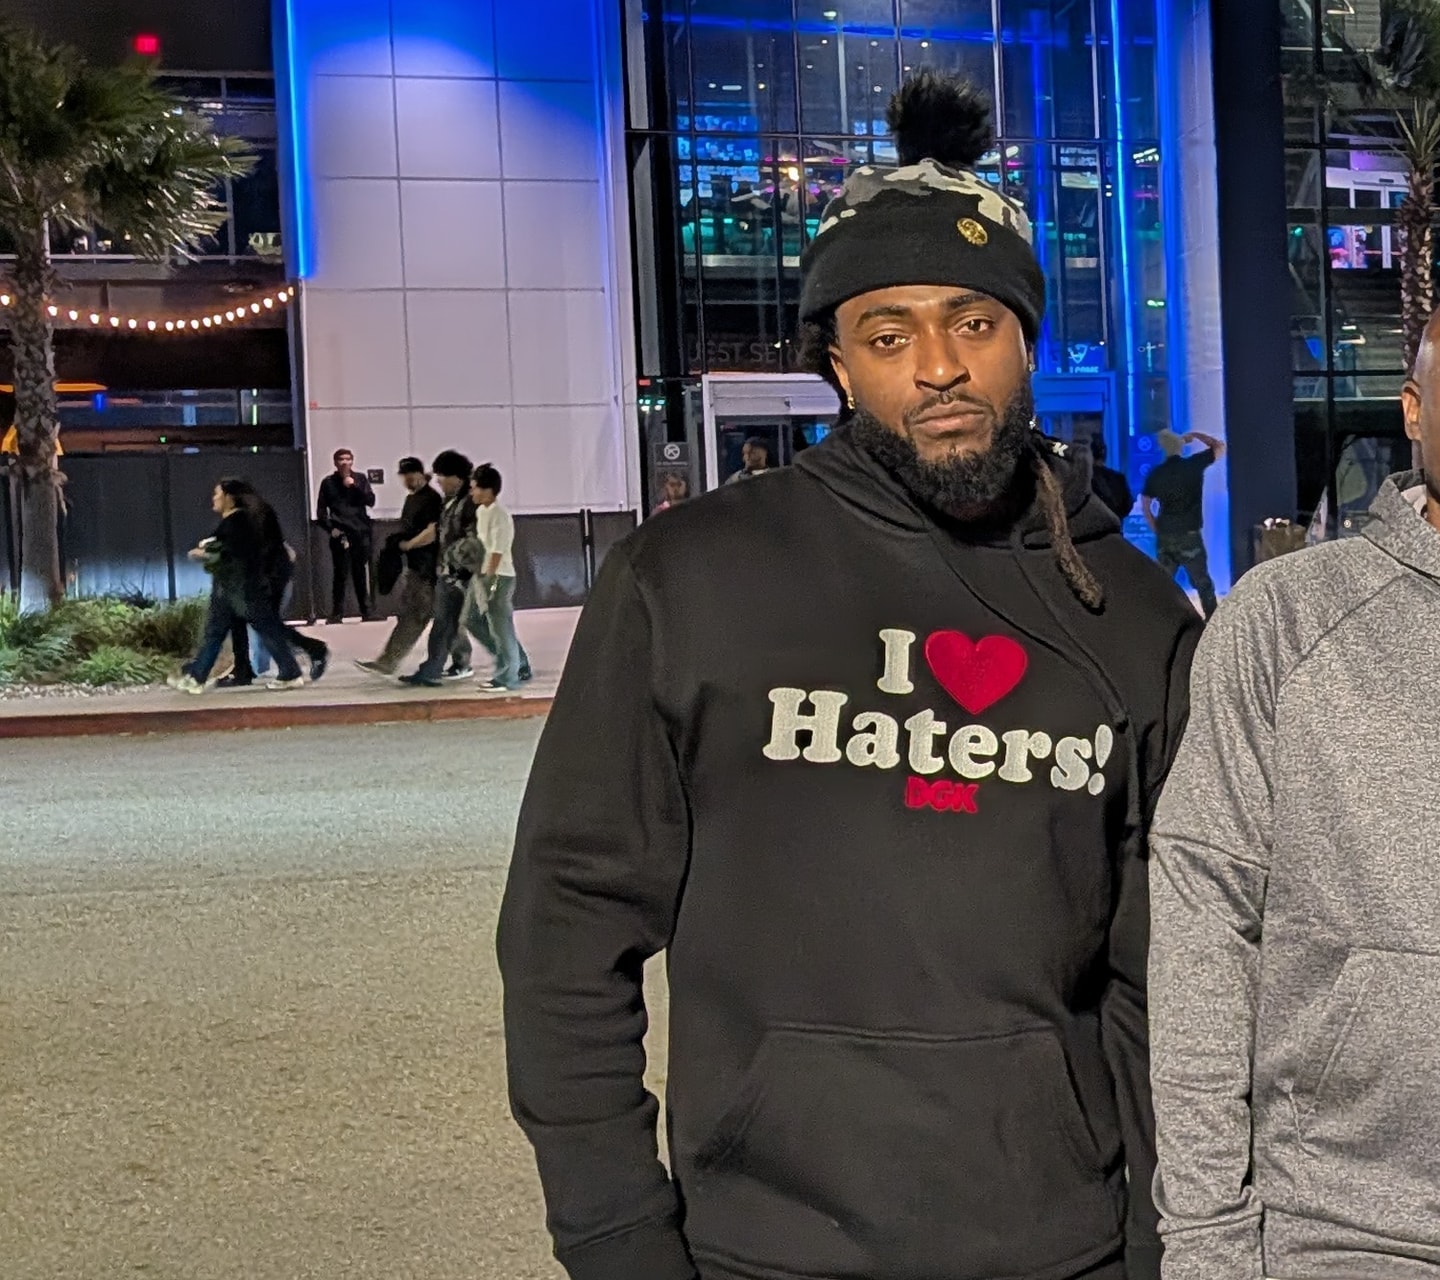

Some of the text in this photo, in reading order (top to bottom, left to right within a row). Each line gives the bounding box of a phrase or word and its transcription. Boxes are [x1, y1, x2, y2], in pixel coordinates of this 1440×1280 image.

[876, 628, 916, 695] I
[762, 686, 1114, 796] Haters!
[905, 775, 979, 814] DGK
